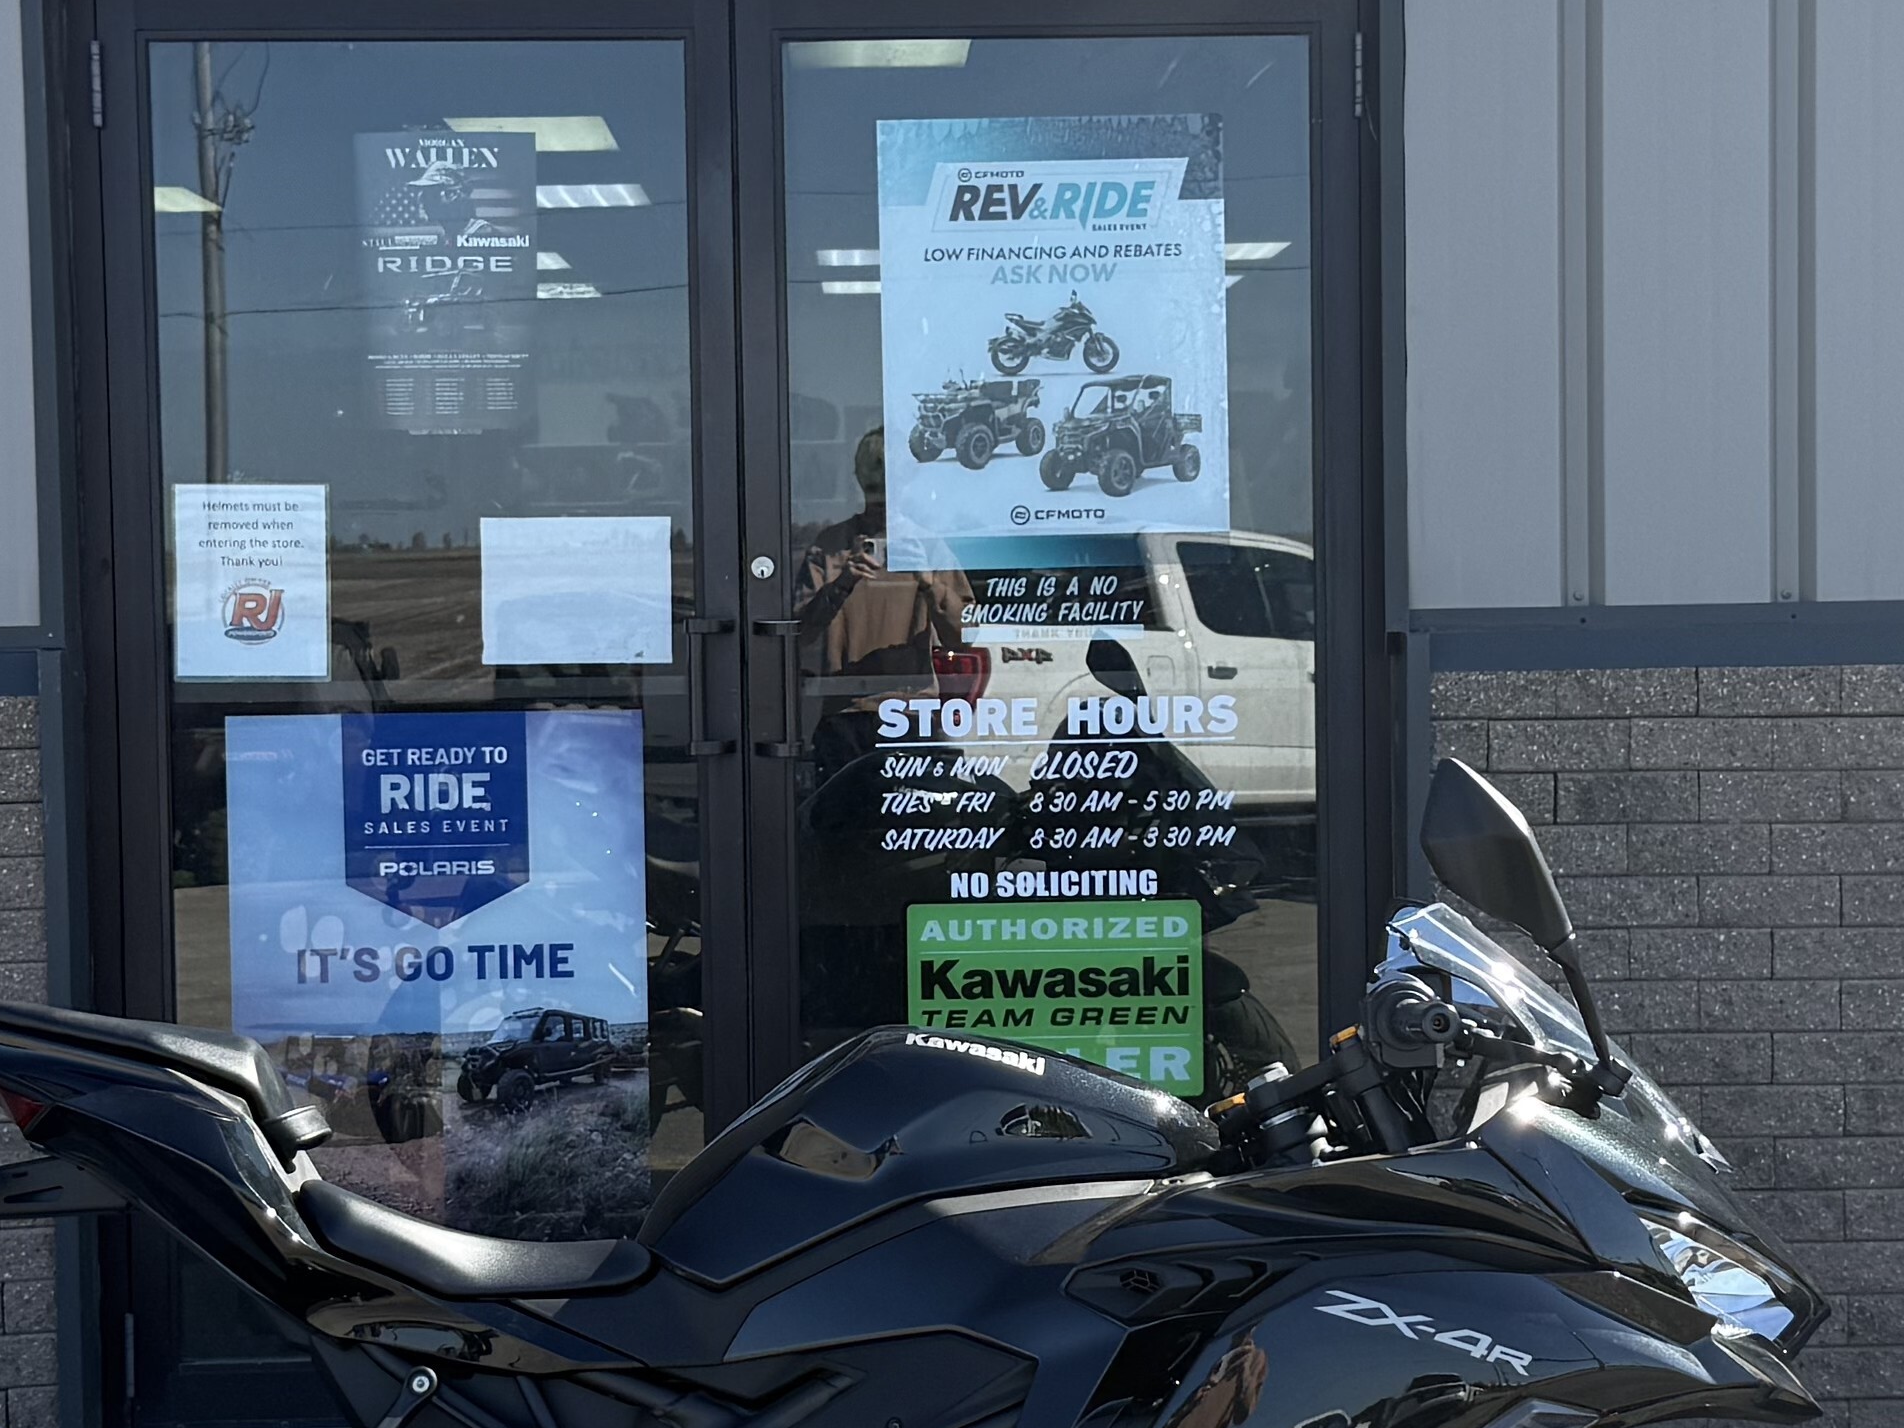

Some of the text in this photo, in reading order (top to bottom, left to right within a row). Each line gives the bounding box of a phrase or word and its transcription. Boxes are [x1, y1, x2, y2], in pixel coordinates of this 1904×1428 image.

[457, 235, 529, 248] Kawasaki
[924, 243, 1182, 262] LOW FINANCING AND REBATES
[377, 256, 513, 272] RIDGE
[991, 262, 1117, 285] ASK NOW
[202, 501, 300, 512] Helmets must be
[1035, 509, 1105, 520] CFMOTO
[207, 521, 294, 531] removed when
[198, 538, 305, 550] entering the store.
[220, 556, 283, 568] Thank you!
[987, 575, 1118, 597] THIS IS A NO
[229, 589, 285, 630] RJ
[961, 600, 1144, 624] SMOKING FACILITY
[877, 695, 1239, 738] STORE HOURS
[362, 747, 508, 766] GET READY TO
[880, 756, 931, 779] SUN
[950, 756, 1009, 777] MON
[1029, 750, 1139, 780] CLOSED
[380, 772, 491, 814] RIDE
[880, 792, 934, 815] TUES
[956, 792, 996, 813] FRI
[1080, 790, 1124, 812] AM
[1195, 789, 1236, 811] PM
[364, 819, 509, 835] SALES EVENT
[881, 827, 1005, 851] SATURDAY
[1080, 826, 1124, 848] AM
[1196, 825, 1237, 847] PM
[380, 860, 495, 876] POLARIS
[950, 870, 1158, 898] NO SOLICITING
[920, 916, 1189, 942] AUTHORIZED
[297, 943, 575, 984] IT'S GO TIME
[920, 955, 1190, 1001] Kawasaki
[922, 1005, 1190, 1028] TEAM GREEN
[905, 1033, 1046, 1076] Kawasaki
[1314, 1290, 1533, 1376] ZX-4R
